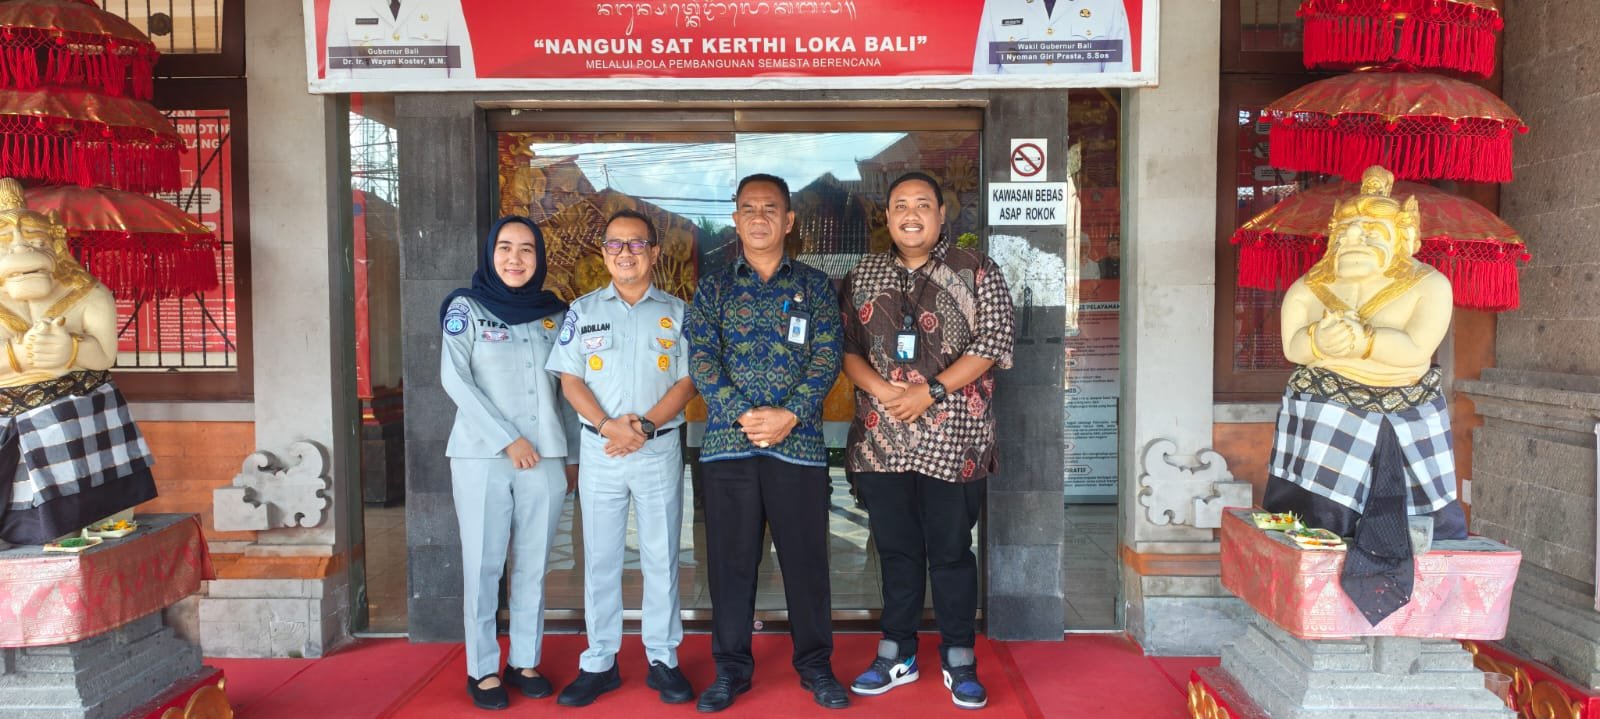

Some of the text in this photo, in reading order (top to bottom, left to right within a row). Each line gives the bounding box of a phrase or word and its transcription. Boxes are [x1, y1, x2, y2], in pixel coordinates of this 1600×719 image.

[534, 35, 928, 54] “NANGUN SAT KERTHI LOKA BALI”
[1040, 42, 1075, 50] Gubernur
[367, 47, 419, 55] Gubernur Bali
[1086, 52, 1110, 60] S.Sos
[371, 57, 397, 66] Wayan
[398, 58, 426, 66] Koster,
[428, 57, 446, 65] M.M.
[586, 57, 881, 69] MELALUI POLA PEMBANGUNAN SEMESTA BERENCANA
[992, 188, 1064, 202] KAWASAN BEBAS
[999, 207, 1056, 220] ASAP ROKOK
[477, 318, 509, 330] TIFA
